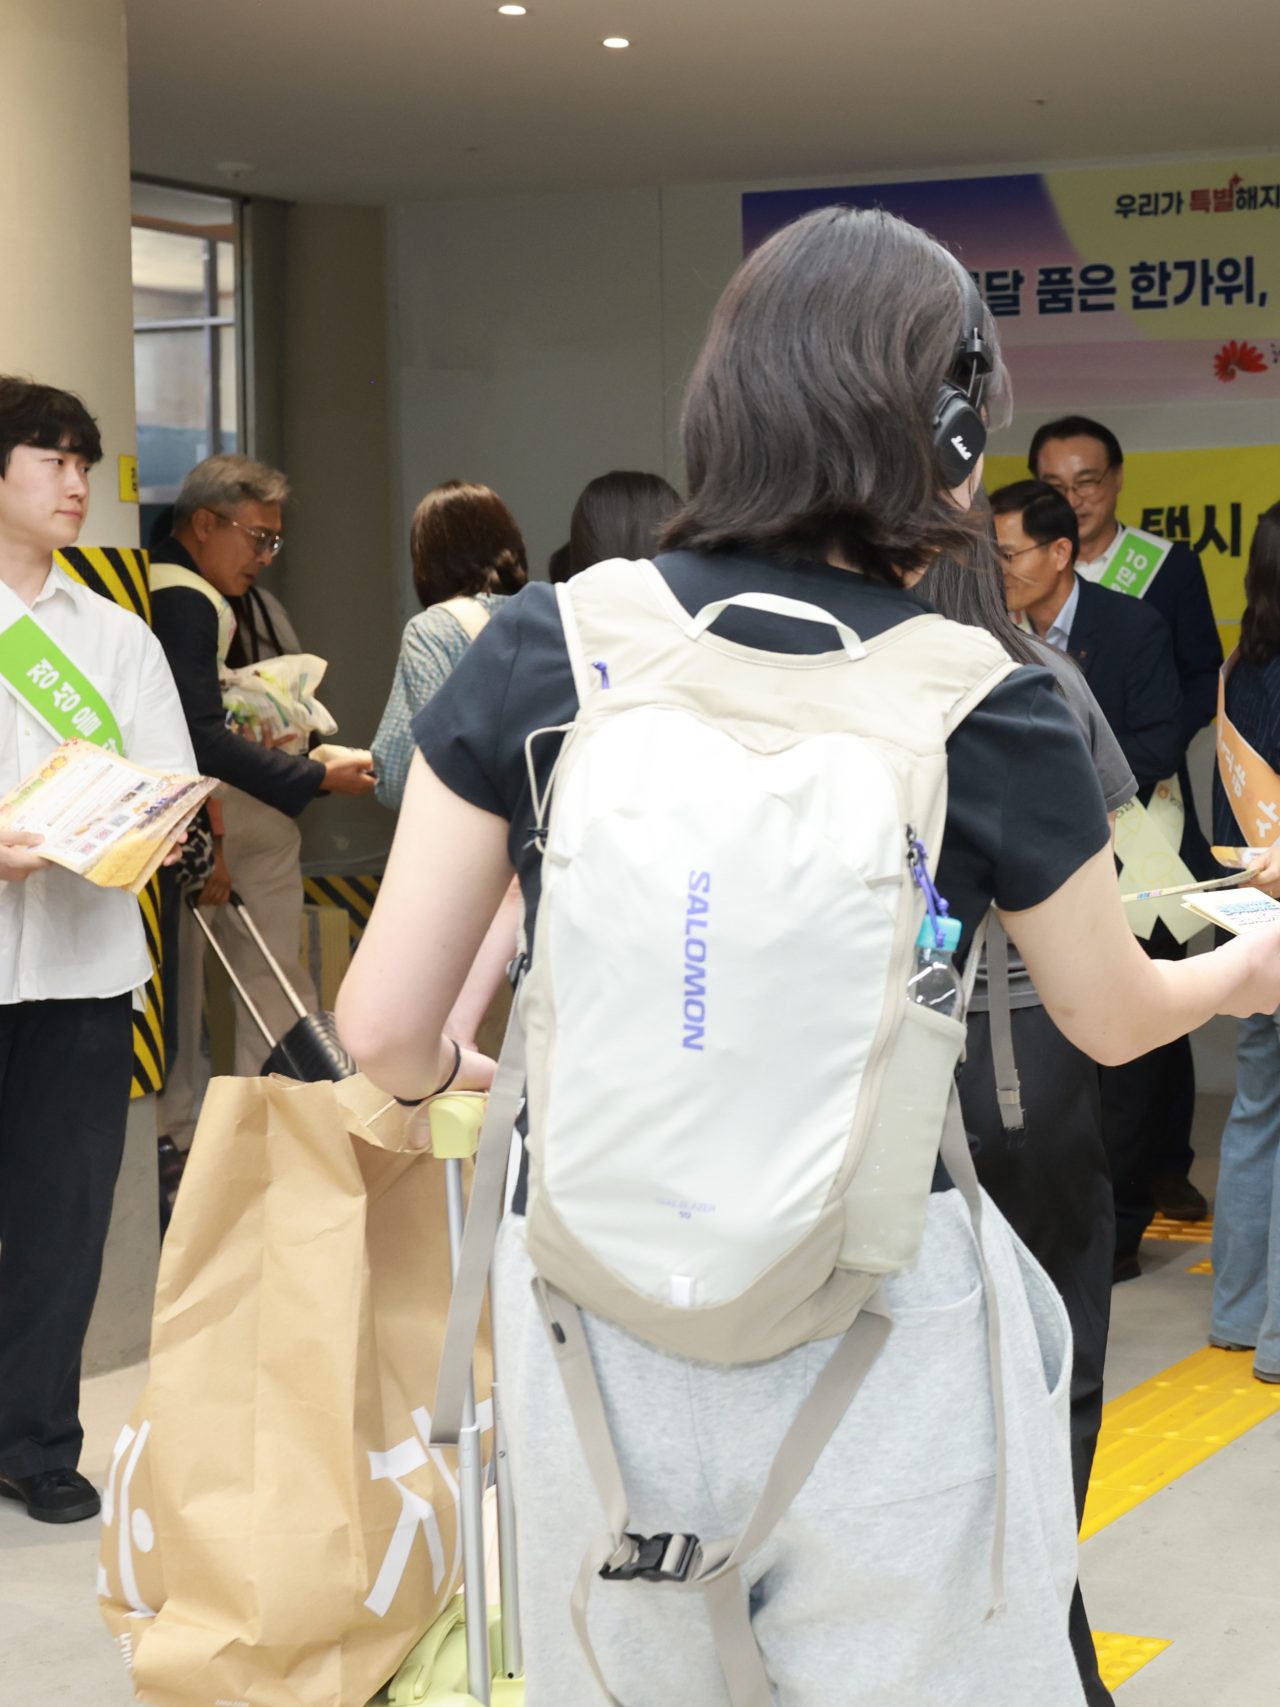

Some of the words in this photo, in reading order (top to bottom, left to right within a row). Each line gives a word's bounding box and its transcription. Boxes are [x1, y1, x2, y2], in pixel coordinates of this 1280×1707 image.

[1115, 191, 1183, 219] 우리가
[974, 269, 1025, 317] 달
[1036, 262, 1117, 315] 품은
[1129, 255, 1268, 311] 한가위,
[1140, 502, 1241, 557] 택시
[26, 657, 103, 738] 정성을
[682, 869, 712, 1051] SALOMON
